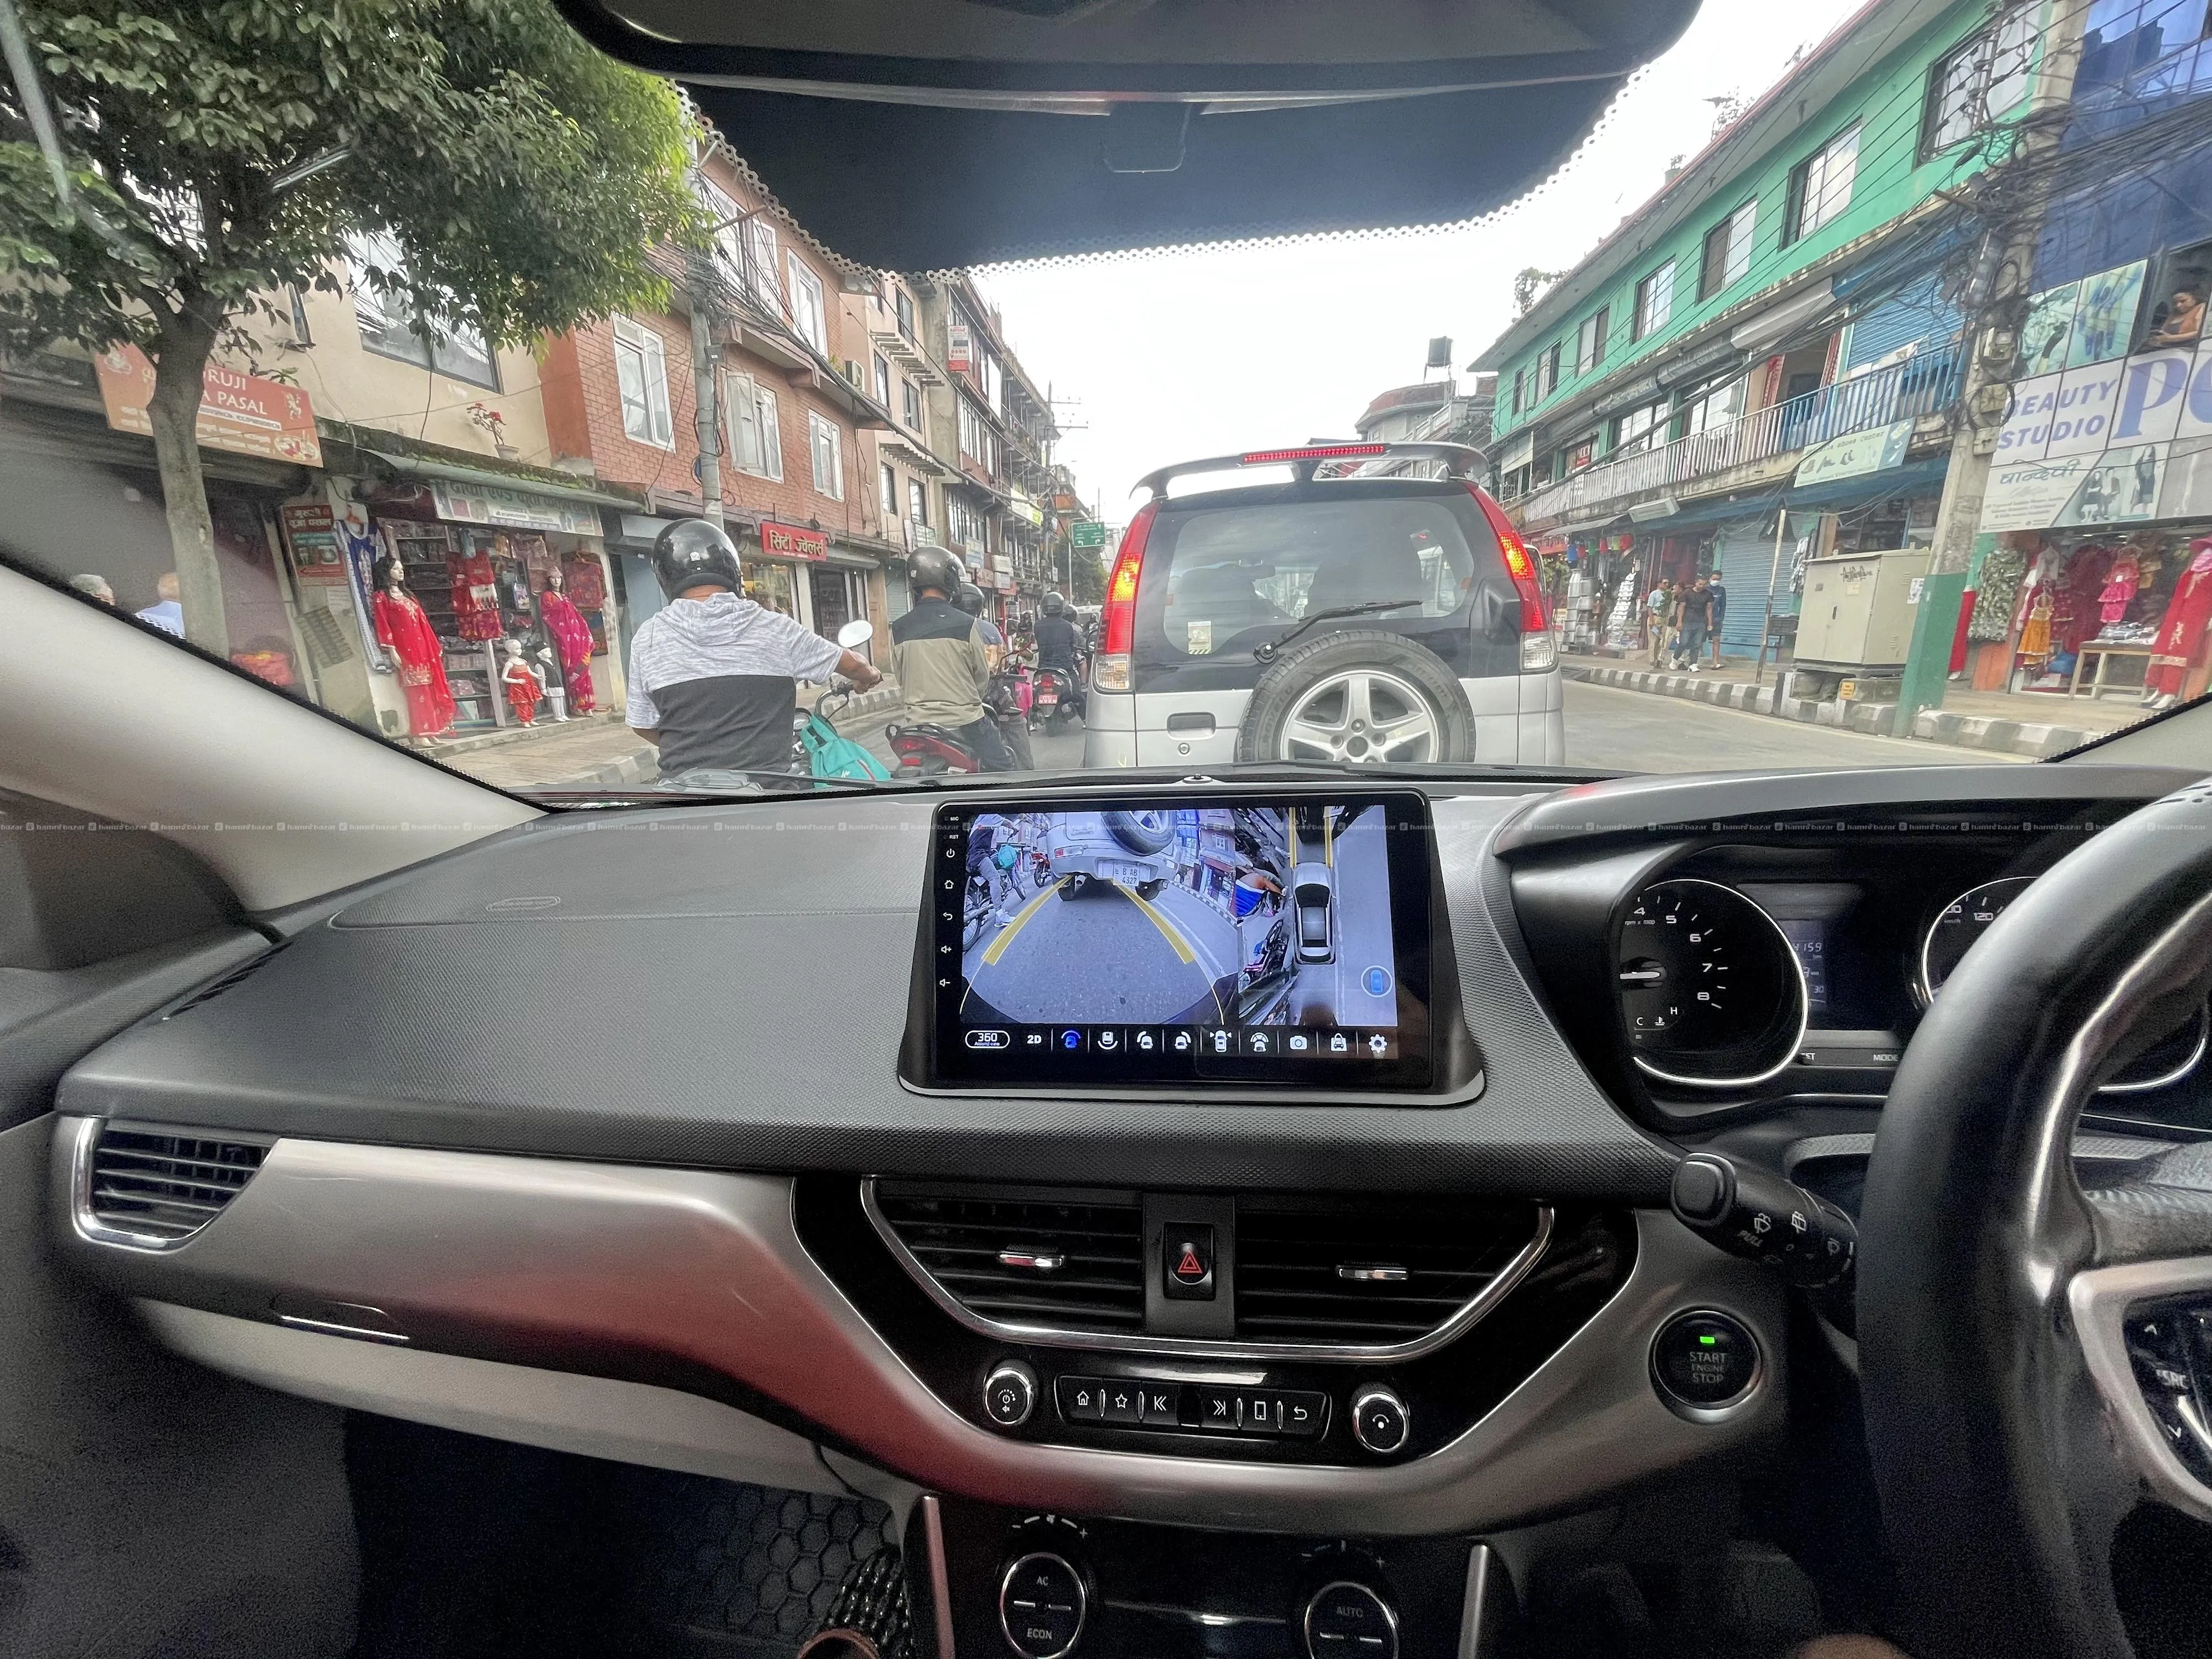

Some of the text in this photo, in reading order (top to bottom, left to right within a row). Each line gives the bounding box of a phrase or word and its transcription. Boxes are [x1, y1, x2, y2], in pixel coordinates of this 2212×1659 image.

[203, 368, 246, 391] RUJI
[217, 391, 268, 415] PASAL
[2006, 379, 2119, 417] BEAUTY
[1997, 415, 2105, 449] STUDIO
[769, 529, 792, 550] सिटी
[1633, 907, 1646, 916] 4
[1974, 912, 1994, 921] 120
[1666, 915, 1677, 924] 5
[1690, 934, 1701, 942] 6
[1702, 963, 1713, 973] 7
[1697, 992, 1710, 1001] 8
[1670, 1007, 1678, 1015] H
[1636, 1017, 1644, 1026] C
[978, 1032, 998, 1042] 360
[1026, 1035, 1042, 1044] 2D
[1690, 1351, 1728, 1363] START
[1691, 1363, 1724, 1373] ENGINE
[1692, 1373, 1724, 1383] STOP
[1036, 1576, 1049, 1587] AC
[1335, 1606, 1364, 1618] AUTO
[1026, 1627, 1053, 1640] ECON
